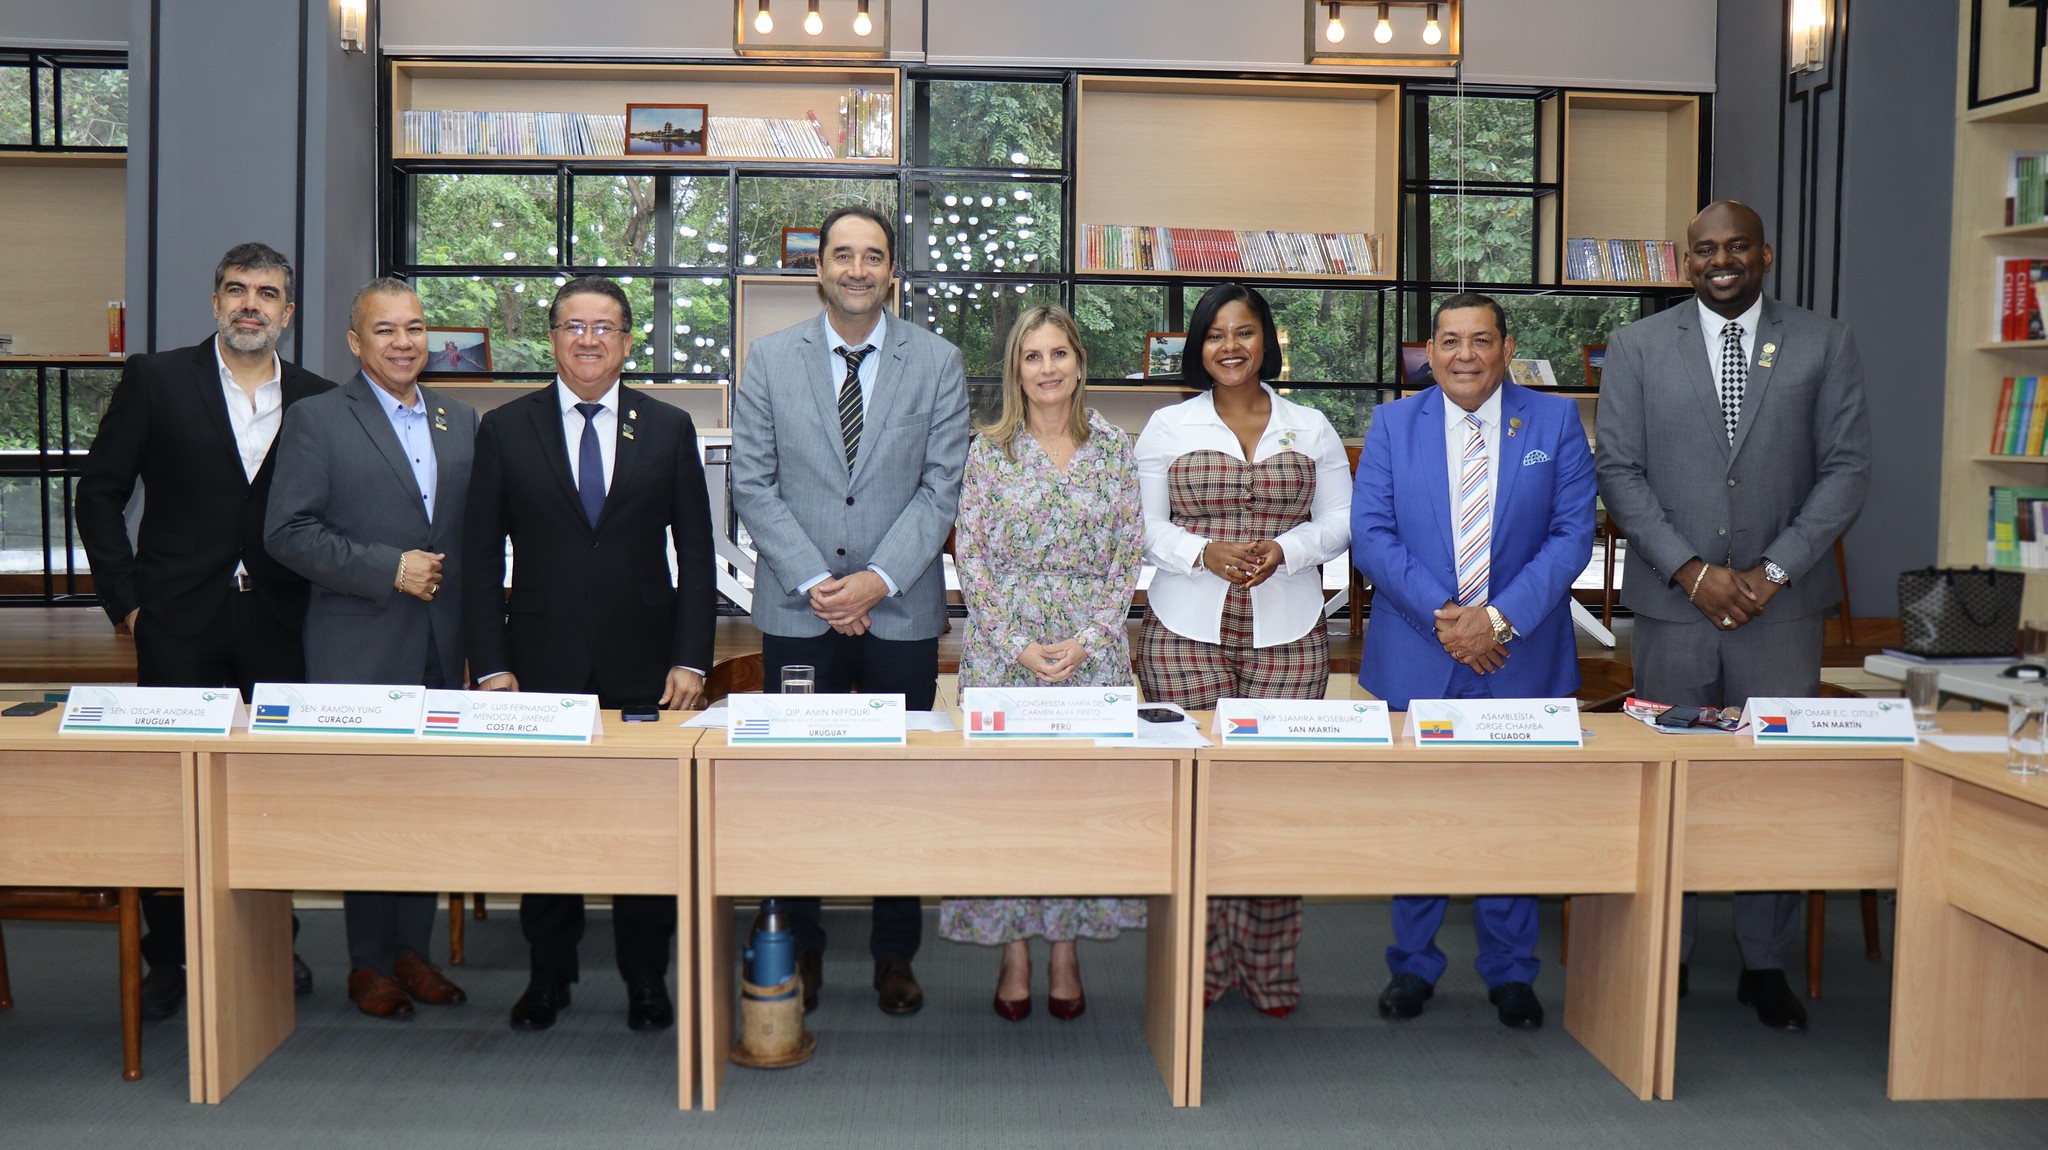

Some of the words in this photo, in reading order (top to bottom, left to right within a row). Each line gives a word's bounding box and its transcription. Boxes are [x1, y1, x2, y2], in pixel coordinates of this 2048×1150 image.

[2003, 272, 2013, 316] CHINA
[2016, 272, 2027, 316] CHINA
[472, 702, 488, 711] DIP.
[491, 703, 508, 711] LUIS
[510, 704, 559, 713] FERNANDO
[1016, 699, 1066, 708] CONGRESISTA
[1092, 700, 1106, 708] DEL
[110, 707, 127, 715] SEN.
[130, 707, 162, 716] OSCAR
[161, 708, 206, 717] ANDRADE
[300, 704, 318, 713] SEN.
[357, 706, 382, 714] YUNG
[785, 708, 802, 717] DIP.
[805, 708, 829, 717] AMIN
[831, 708, 871, 717] NIFFOURI
[1022, 708, 1054, 717] CARMEN
[1055, 708, 1075, 716] ALVA
[1076, 708, 1101, 717] PRIETO
[473, 713, 519, 722] MENDOZA
[1805, 709, 1832, 718] OMAR
[1851, 710, 1879, 719] OTTLEY
[135, 717, 177, 726] URUGUAY
[317, 715, 363, 724] CURAÇAO
[1278, 714, 1315, 723] SJAMIRA
[1317, 715, 1363, 724] ROSEBURG
[486, 723, 515, 731] COSTA
[517, 724, 539, 732] RICA
[1051, 721, 1072, 731] PERÚ
[1475, 722, 1504, 731] JORGE
[1504, 722, 1544, 731] CHAMBA
[1811, 720, 1830, 729] SAN
[1830, 720, 1862, 729] MARTÍN
[809, 729, 848, 737] URUGUAY
[1288, 725, 1306, 734] SAN
[1308, 725, 1341, 734] MARTÍN
[1490, 732, 1532, 740] ECUADOR
